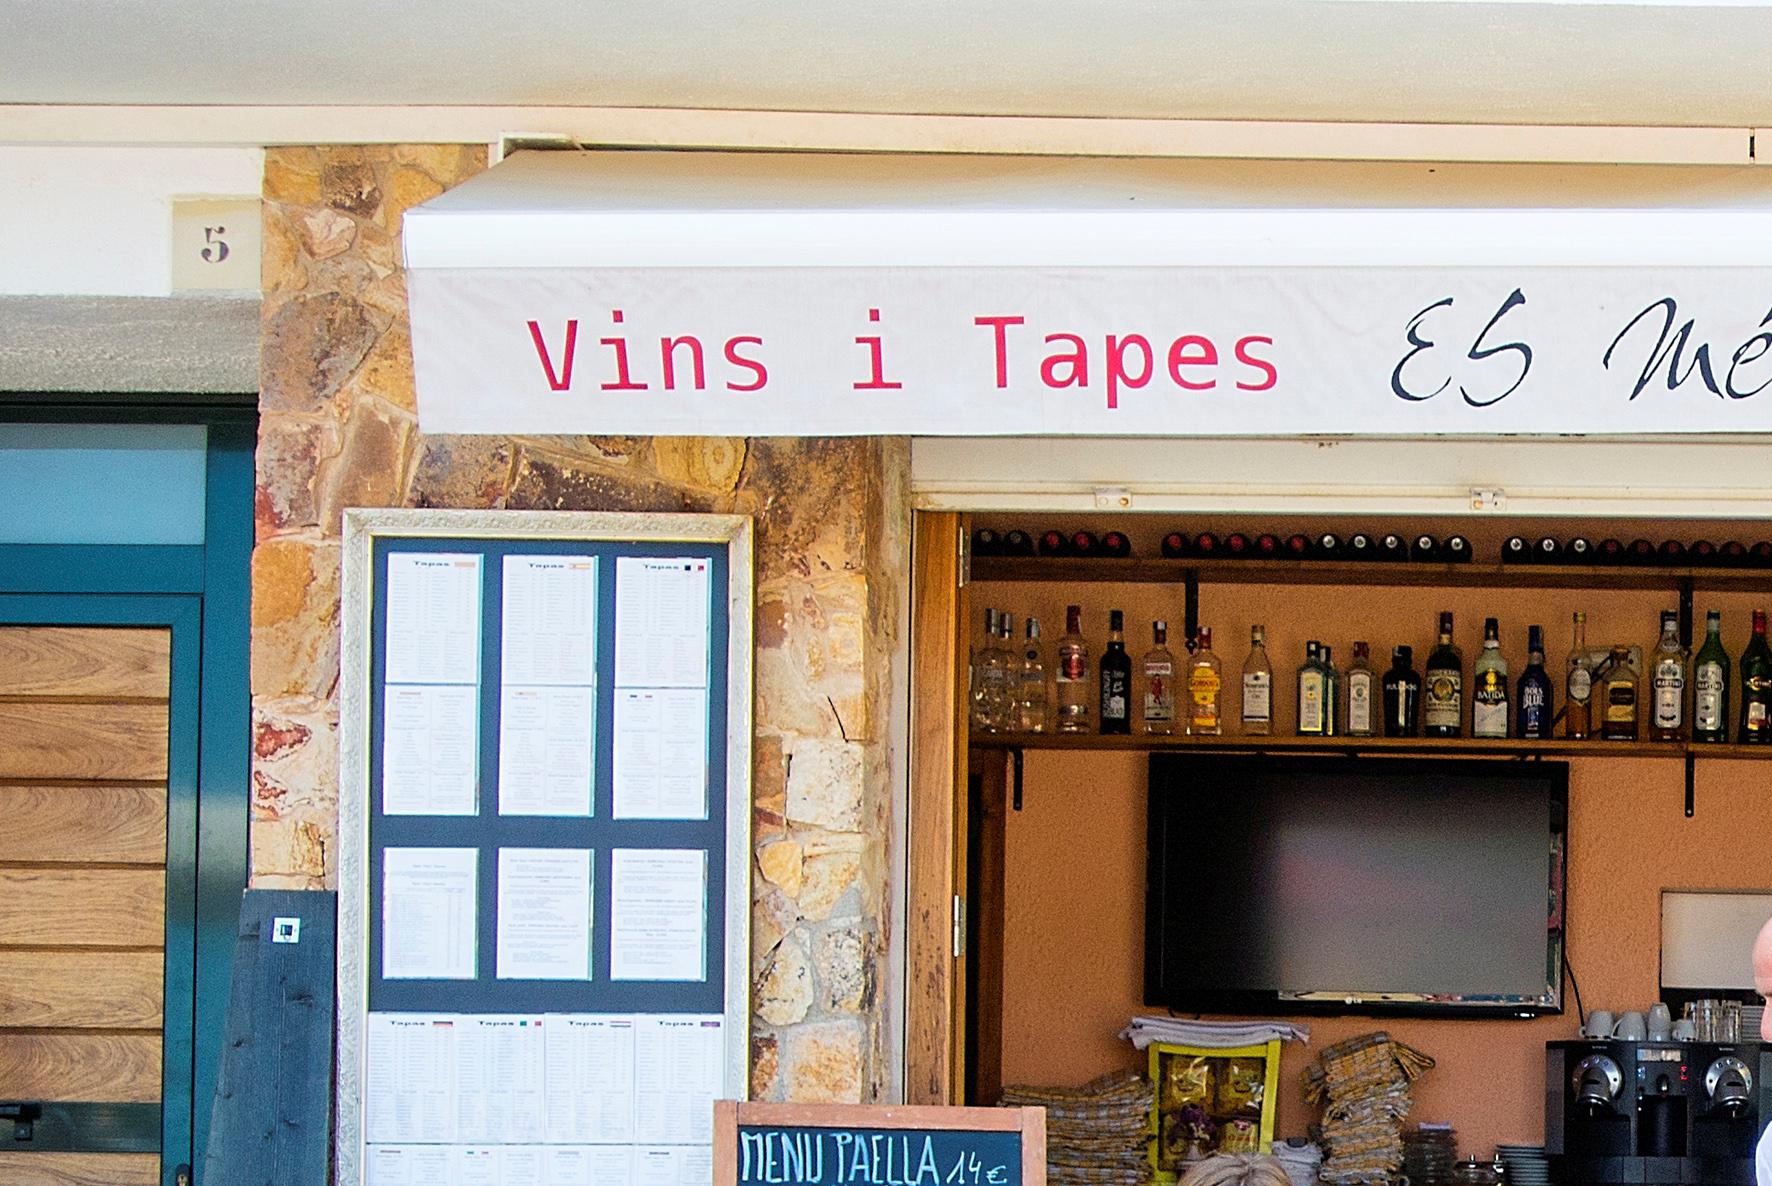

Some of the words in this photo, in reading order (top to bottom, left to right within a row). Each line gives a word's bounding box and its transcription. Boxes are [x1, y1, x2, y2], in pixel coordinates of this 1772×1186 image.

[201, 226, 229, 263] 5
[527, 310, 769, 392] Vins
[852, 309, 902, 389] i
[974, 316, 1279, 408] Tapes
[1477, 691, 1505, 700] BATIDA
[739, 1131, 823, 1183] MENU
